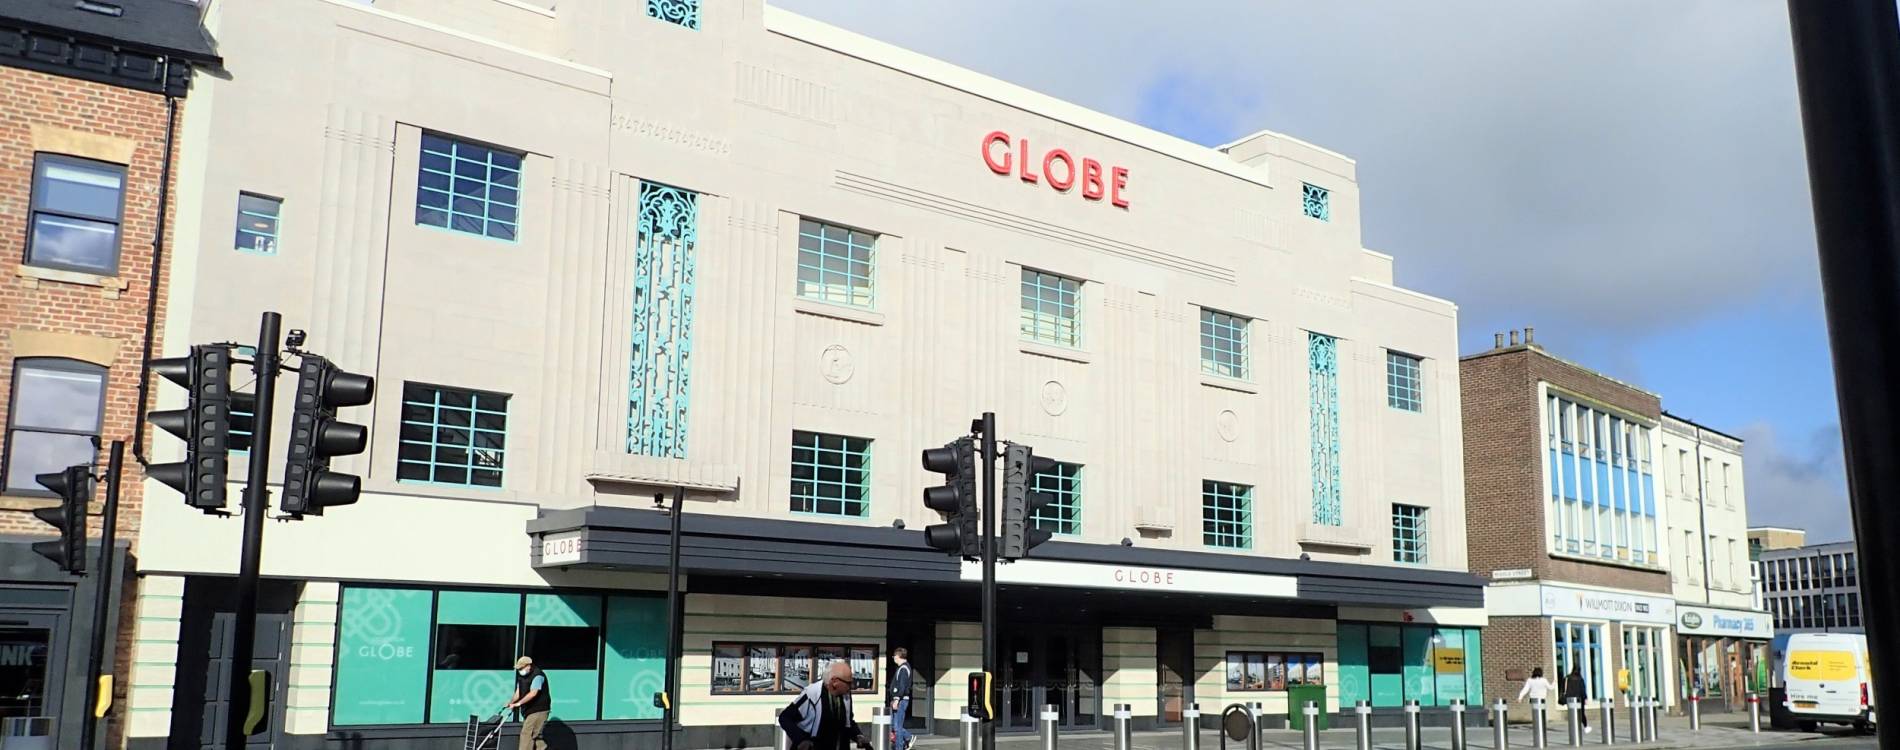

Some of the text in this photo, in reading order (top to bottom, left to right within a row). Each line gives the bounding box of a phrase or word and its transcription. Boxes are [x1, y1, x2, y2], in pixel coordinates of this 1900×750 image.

[981, 130, 1130, 209] GLOBE
[545, 538, 583, 556] GLOBE
[1114, 569, 1174, 585] GLOBE
[1585, 599, 1614, 611] WILLMOTT
[1614, 601, 1633, 612] DIXON
[1713, 614, 1742, 633] Pharmacy
[359, 643, 414, 660] GLOBE
